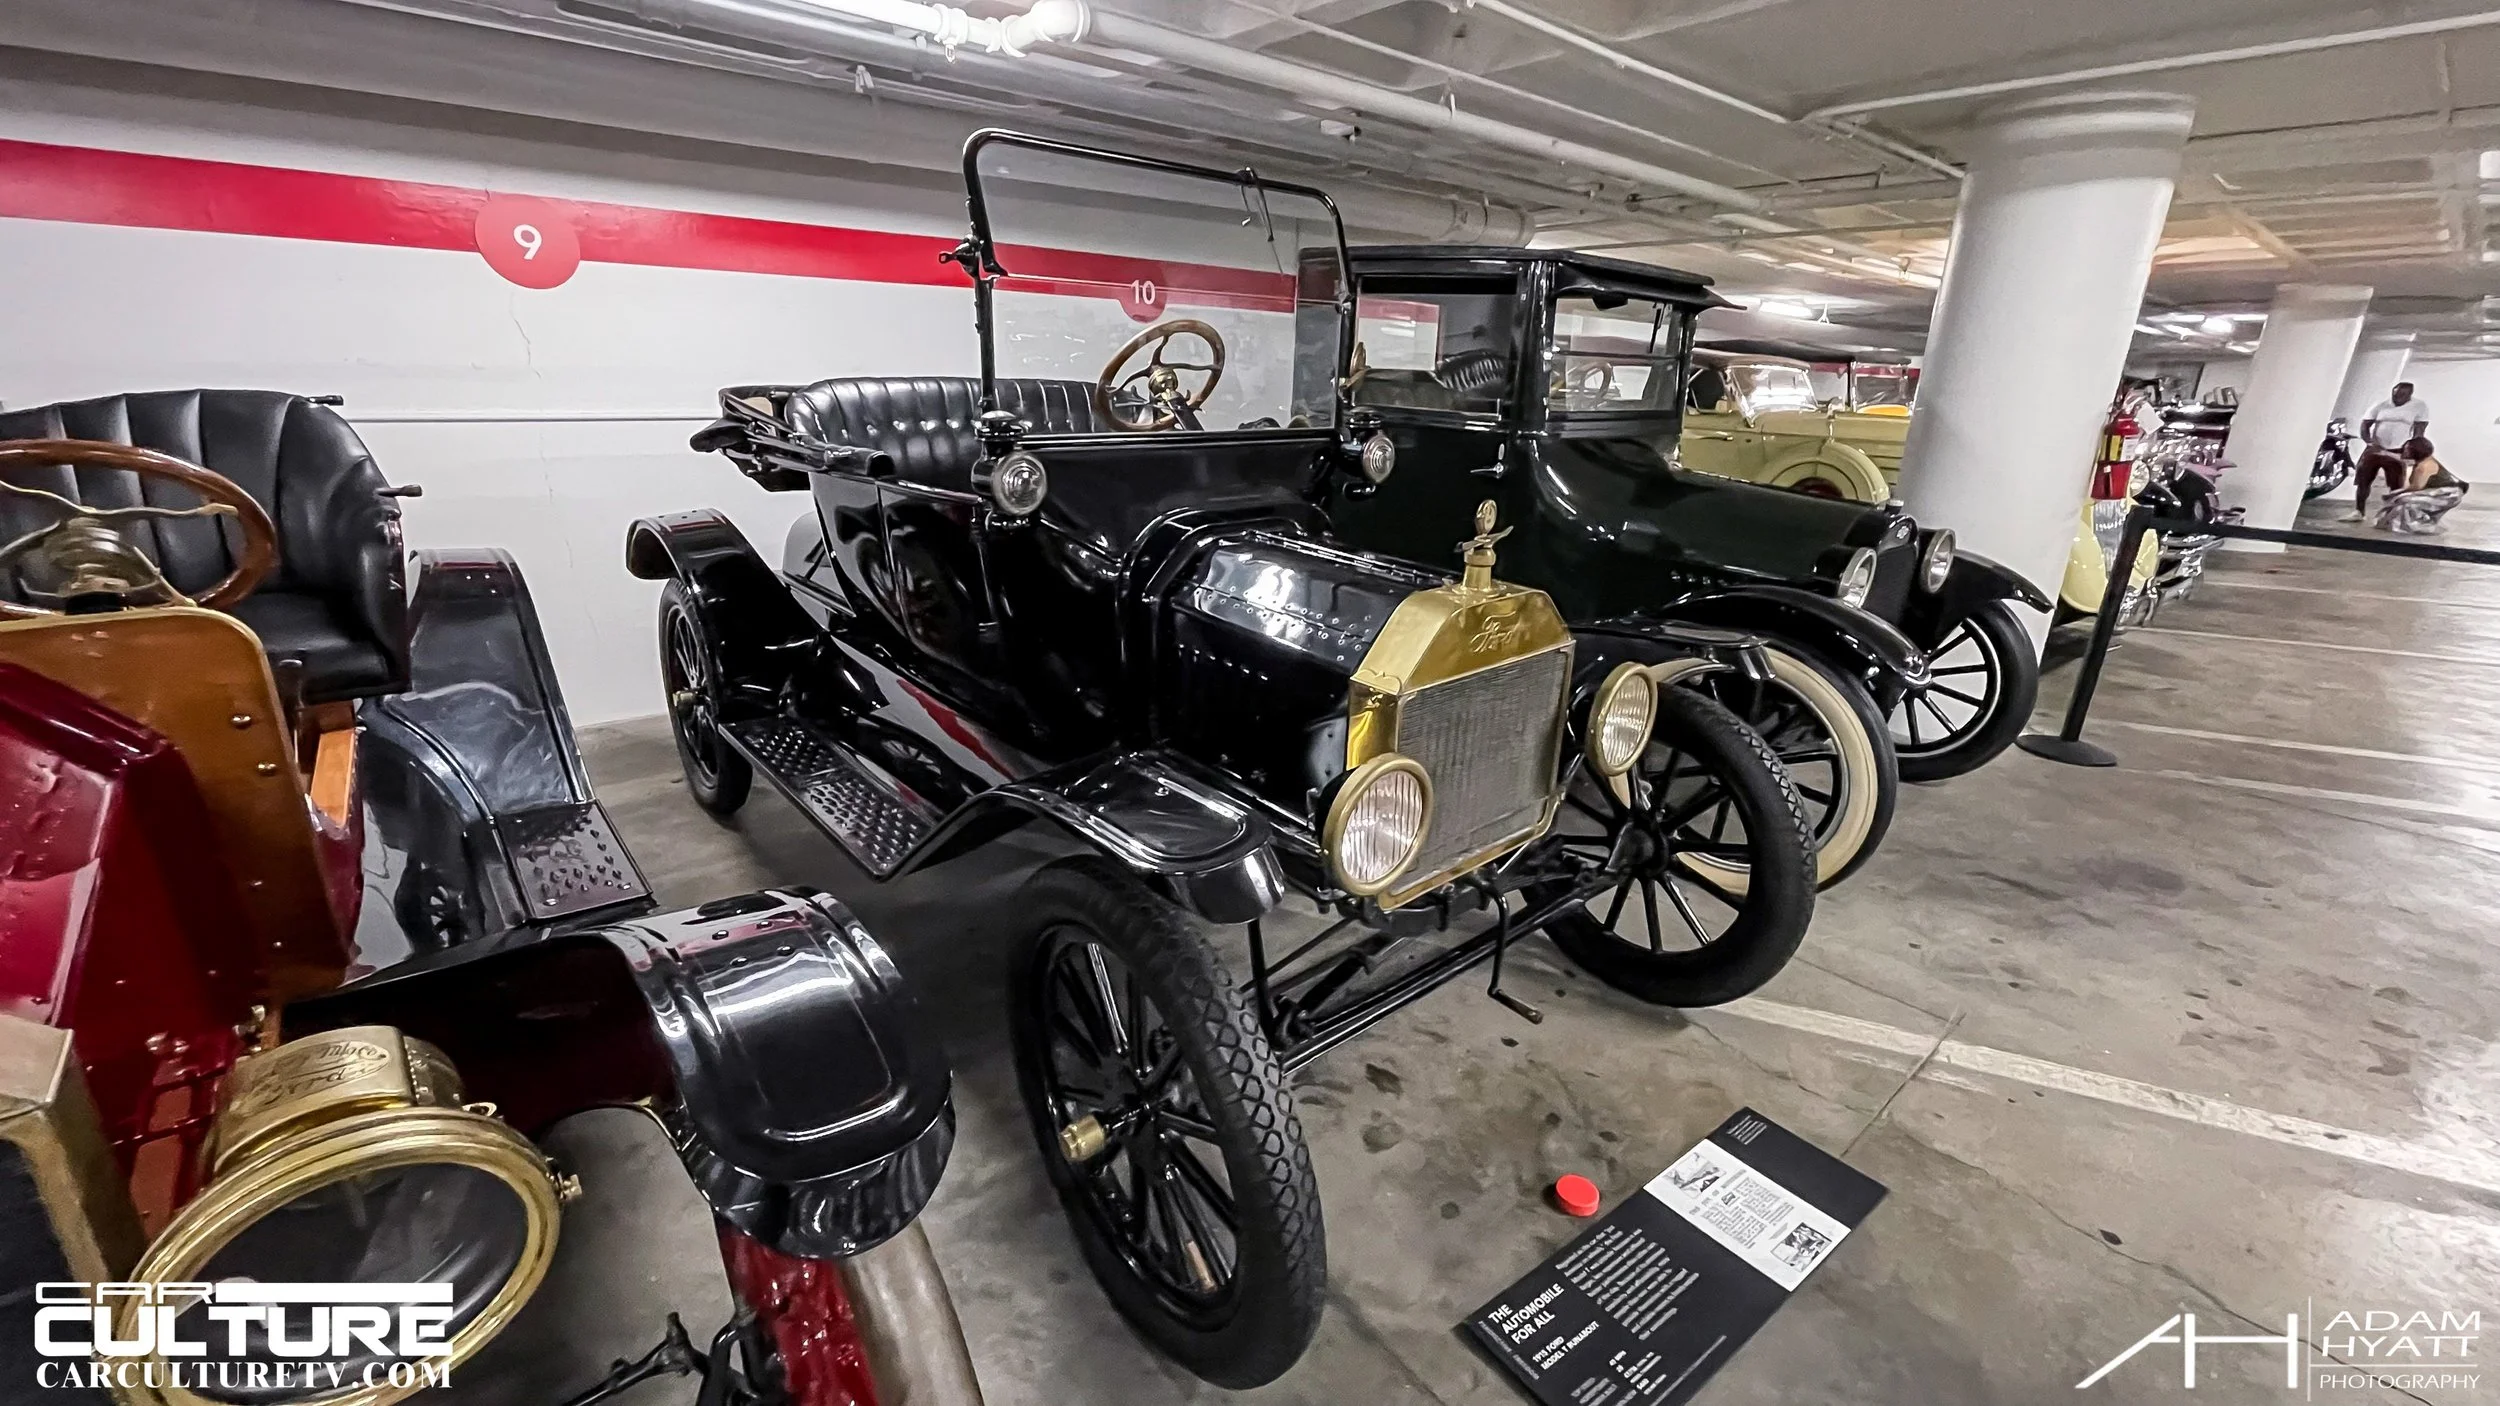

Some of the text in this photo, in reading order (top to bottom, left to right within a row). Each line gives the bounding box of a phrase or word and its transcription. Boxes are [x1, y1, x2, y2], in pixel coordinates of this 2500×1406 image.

[513, 224, 543, 260] 9
[1131, 279, 1156, 305] 10
[1488, 1304, 1512, 1323] THE
[1502, 1283, 1564, 1334] AUTOMOBILE
[1511, 1324, 1536, 1344] FOR
[1534, 1311, 1555, 1329] ALL
[1546, 1336, 1564, 1352] FORD
[1541, 1351, 1564, 1369] MODEL
